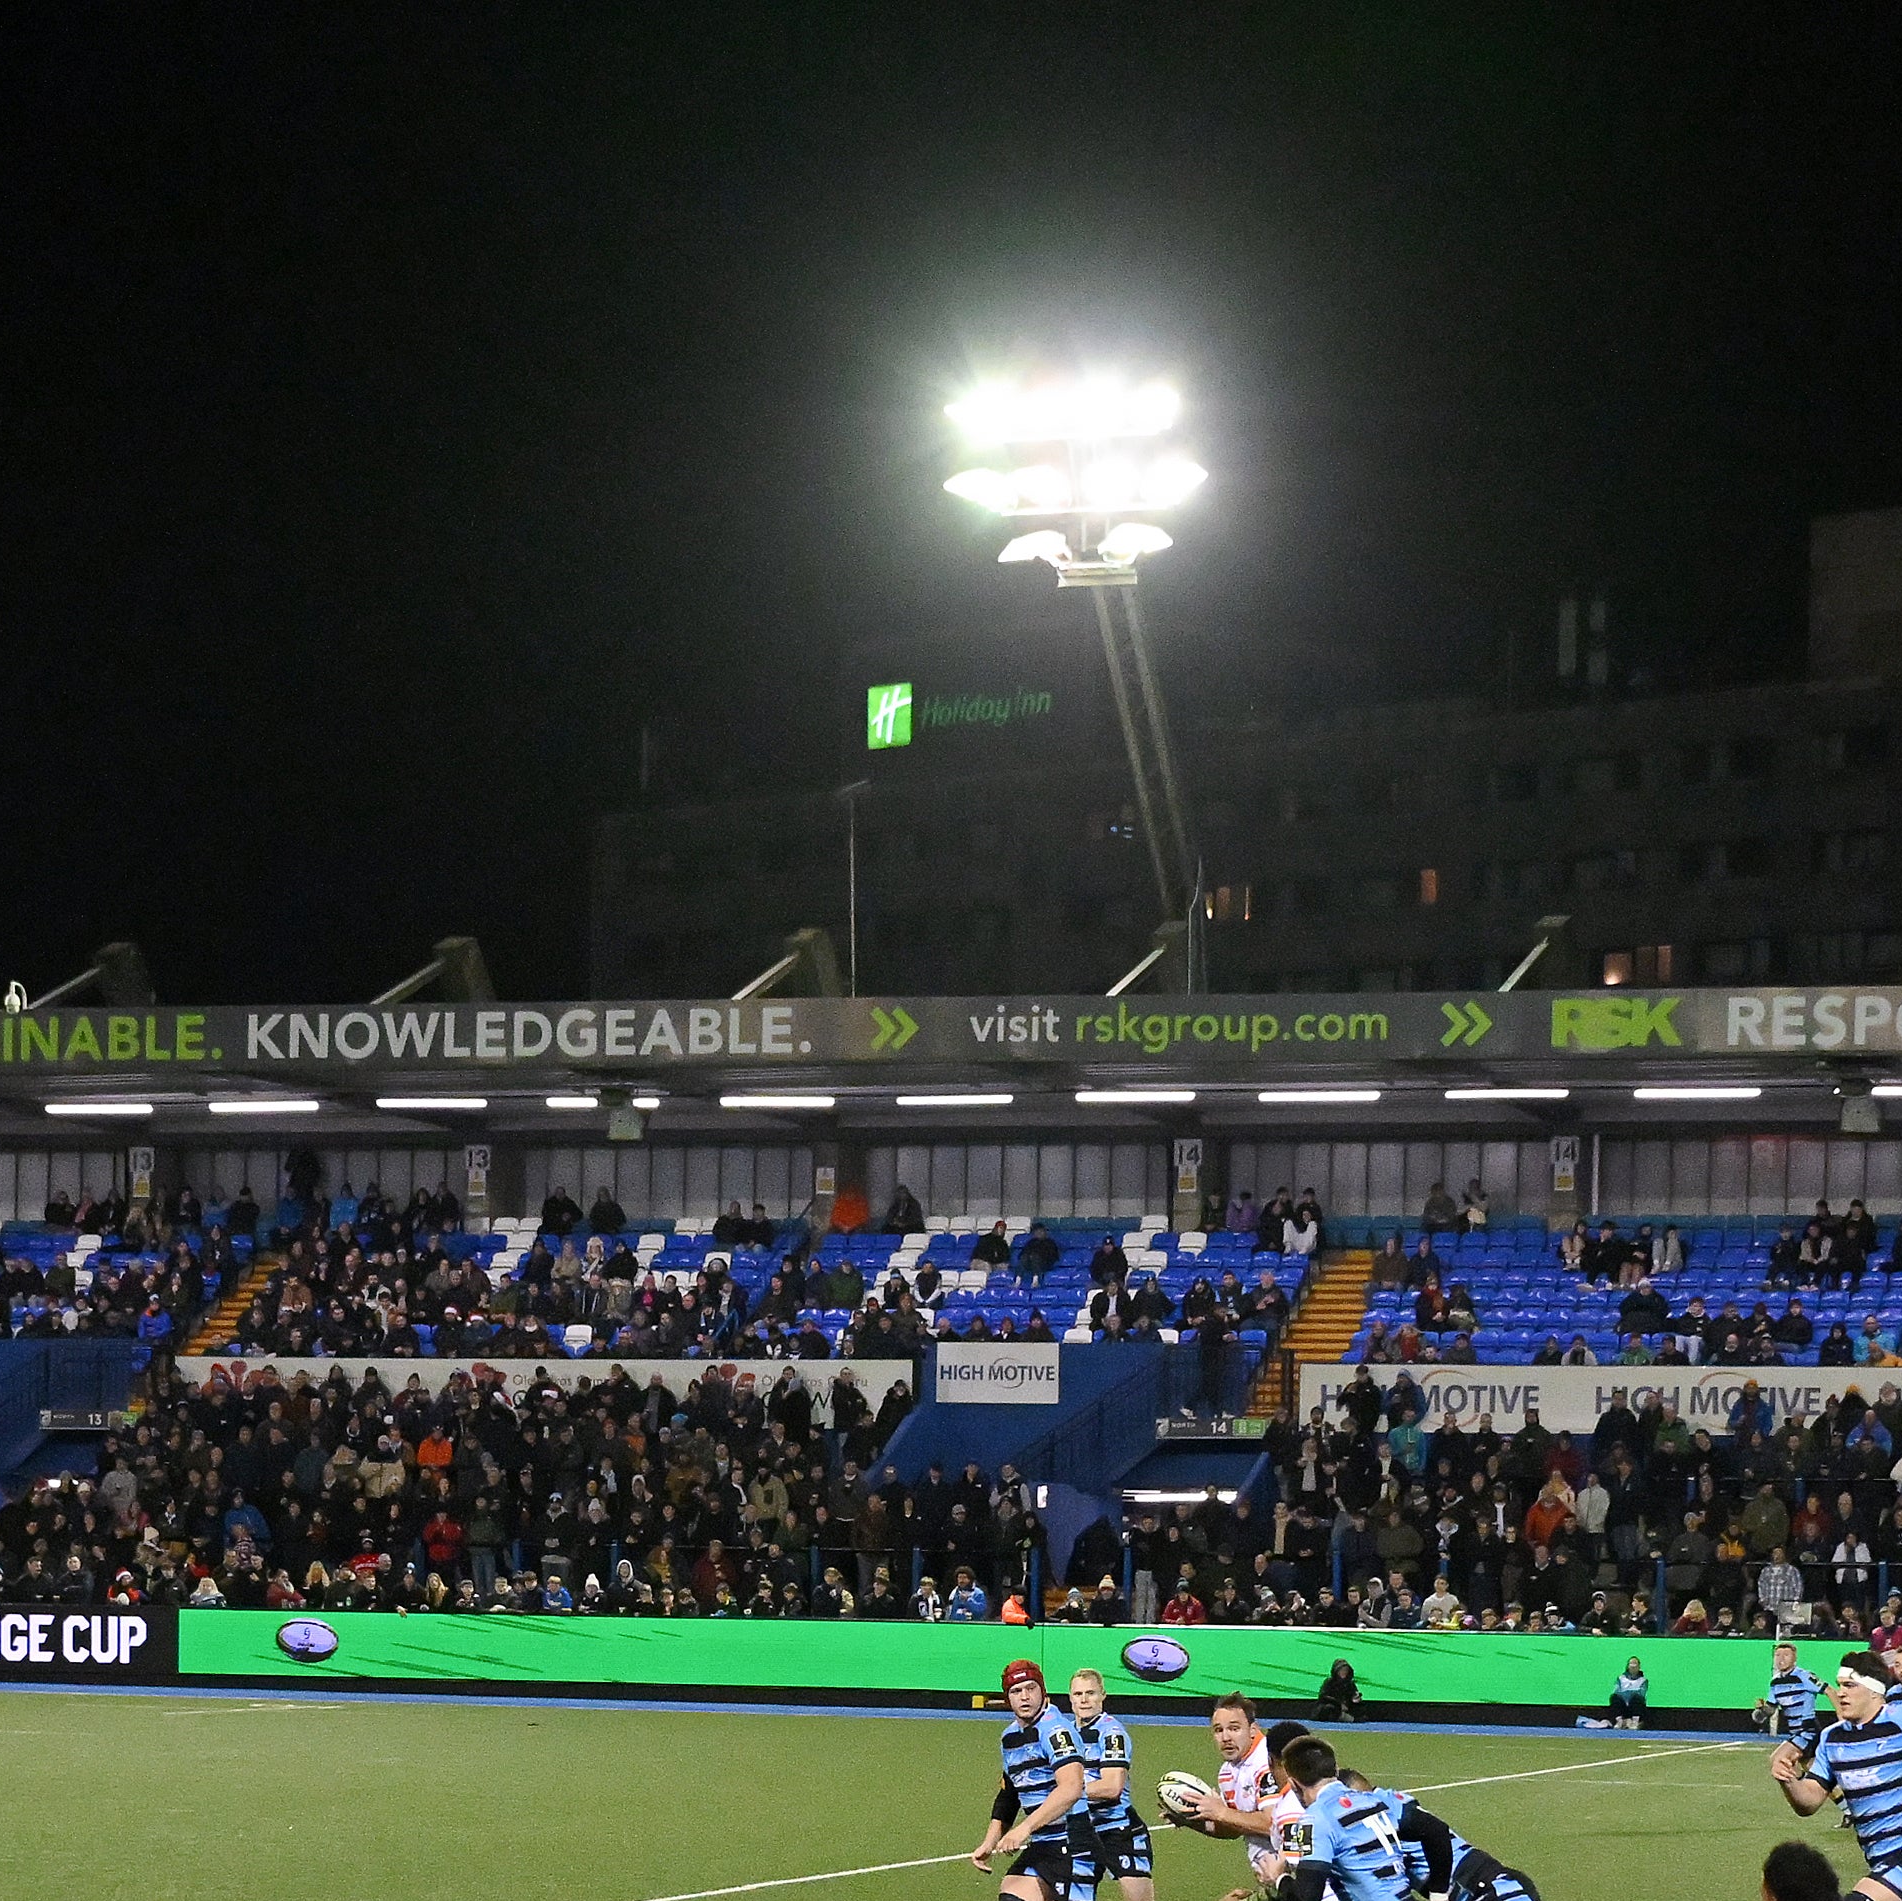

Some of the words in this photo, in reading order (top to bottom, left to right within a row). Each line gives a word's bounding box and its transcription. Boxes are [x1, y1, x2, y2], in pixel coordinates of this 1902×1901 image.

[920, 697, 1010, 728] Holiday
[247, 1006, 811, 1060] KNOWLEDGEABLE.
[969, 1005, 1061, 1044] visit
[1075, 1002, 1389, 1053] rskgroup.com
[1550, 997, 1683, 1049] RSK
[133, 1151, 152, 1172] 13
[468, 1149, 489, 1169] 13
[1178, 1143, 1200, 1165] 14
[1555, 1139, 1576, 1162] 14
[940, 1365, 984, 1381] HIGH
[989, 1365, 1056, 1382] MOTIVE
[88, 1413, 102, 1425] 13
[1210, 1421, 1228, 1435] 14
[62, 1615, 148, 1665] CUP
[1361, 1810, 1403, 1857] 14
